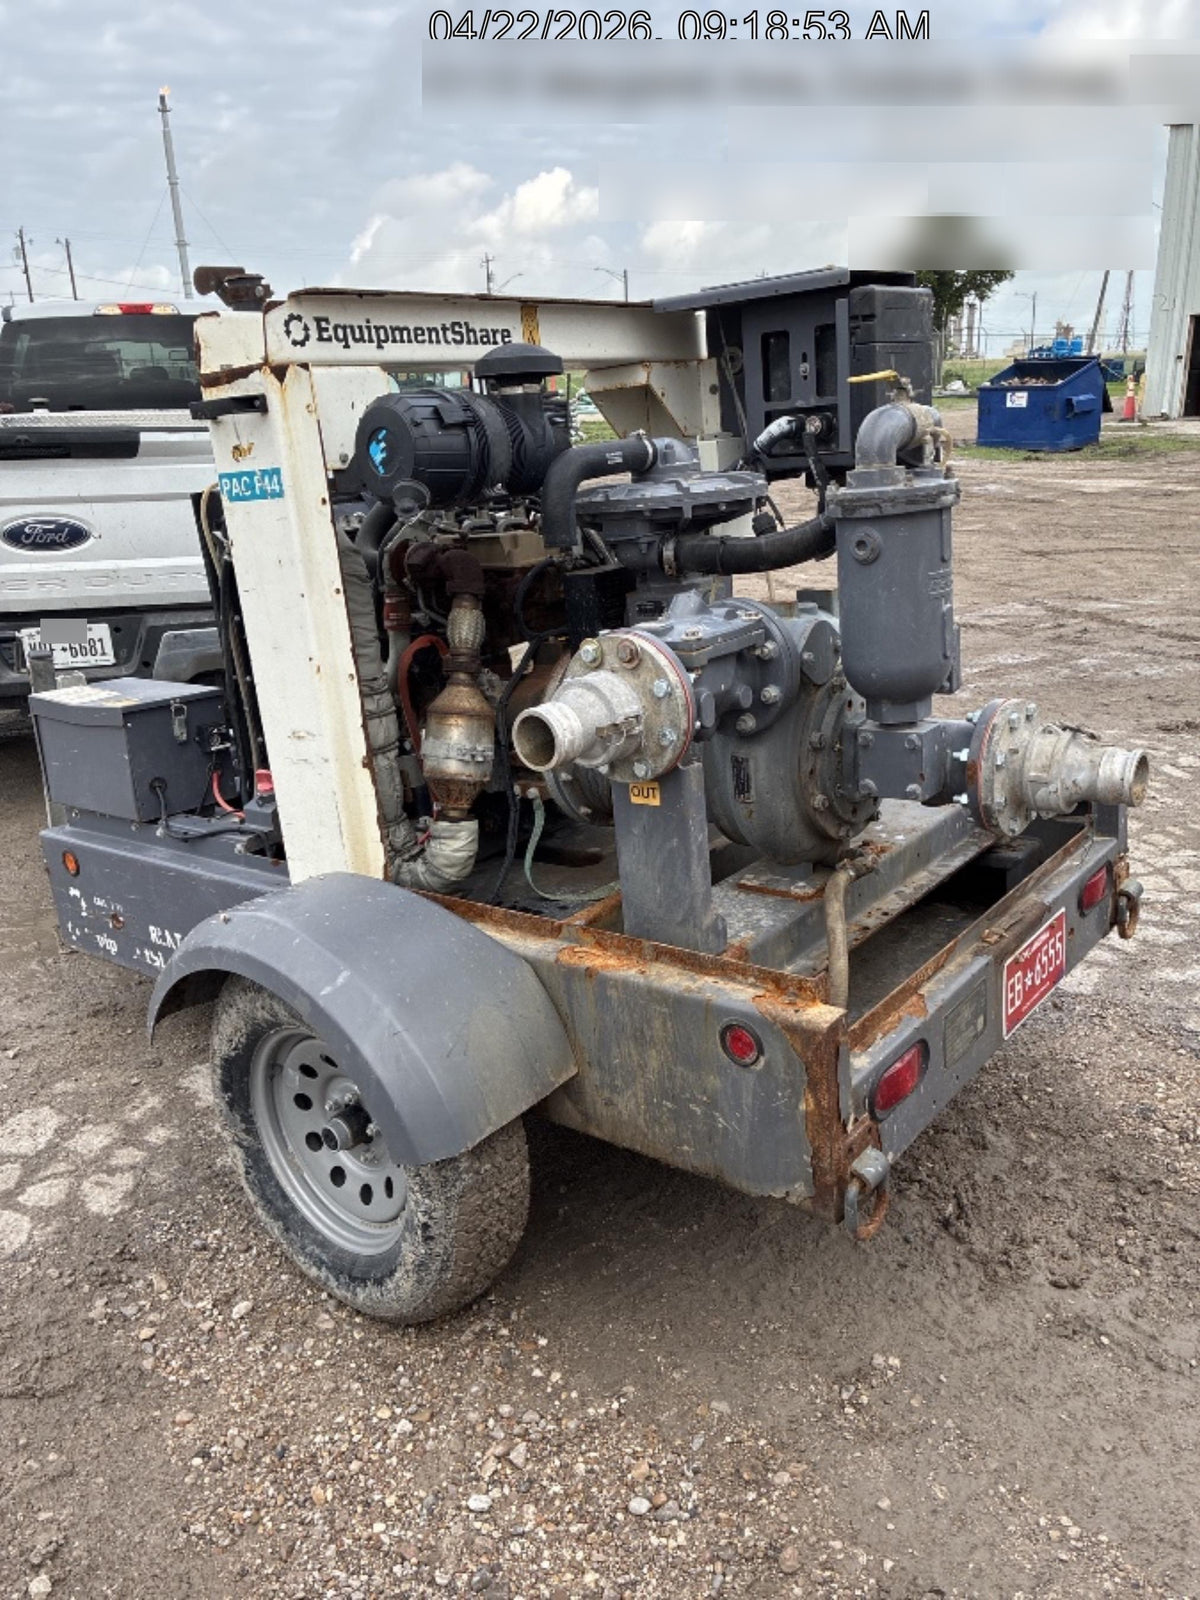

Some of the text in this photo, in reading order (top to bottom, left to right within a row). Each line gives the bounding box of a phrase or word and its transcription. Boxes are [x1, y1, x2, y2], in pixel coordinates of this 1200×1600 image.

[313, 316, 513, 349] EquipmentShare
[222, 474, 252, 496] PAC
[21, 523, 70, 543] Ford
[0, 577, 67, 592] ER
[630, 785, 657, 799] OUT
